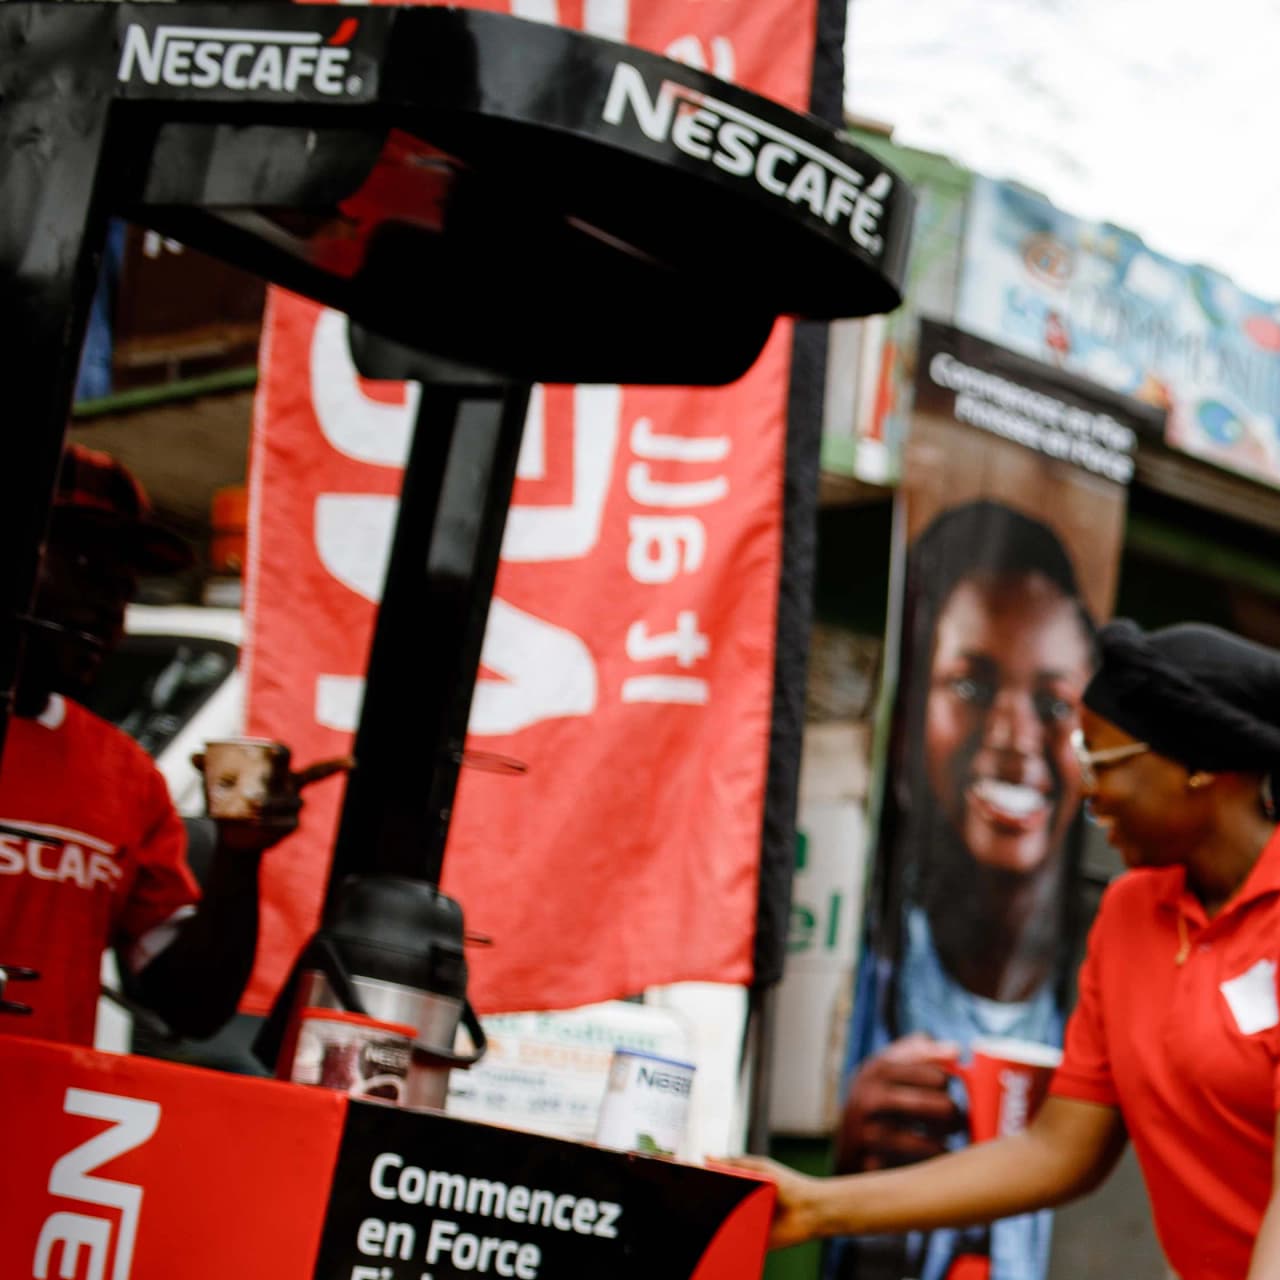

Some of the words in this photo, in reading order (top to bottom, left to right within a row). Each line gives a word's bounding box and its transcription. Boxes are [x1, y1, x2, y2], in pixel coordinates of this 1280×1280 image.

[369, 1152, 622, 1238] Commencez
[357, 1217, 413, 1261] en
[426, 1221, 541, 1280] Force
